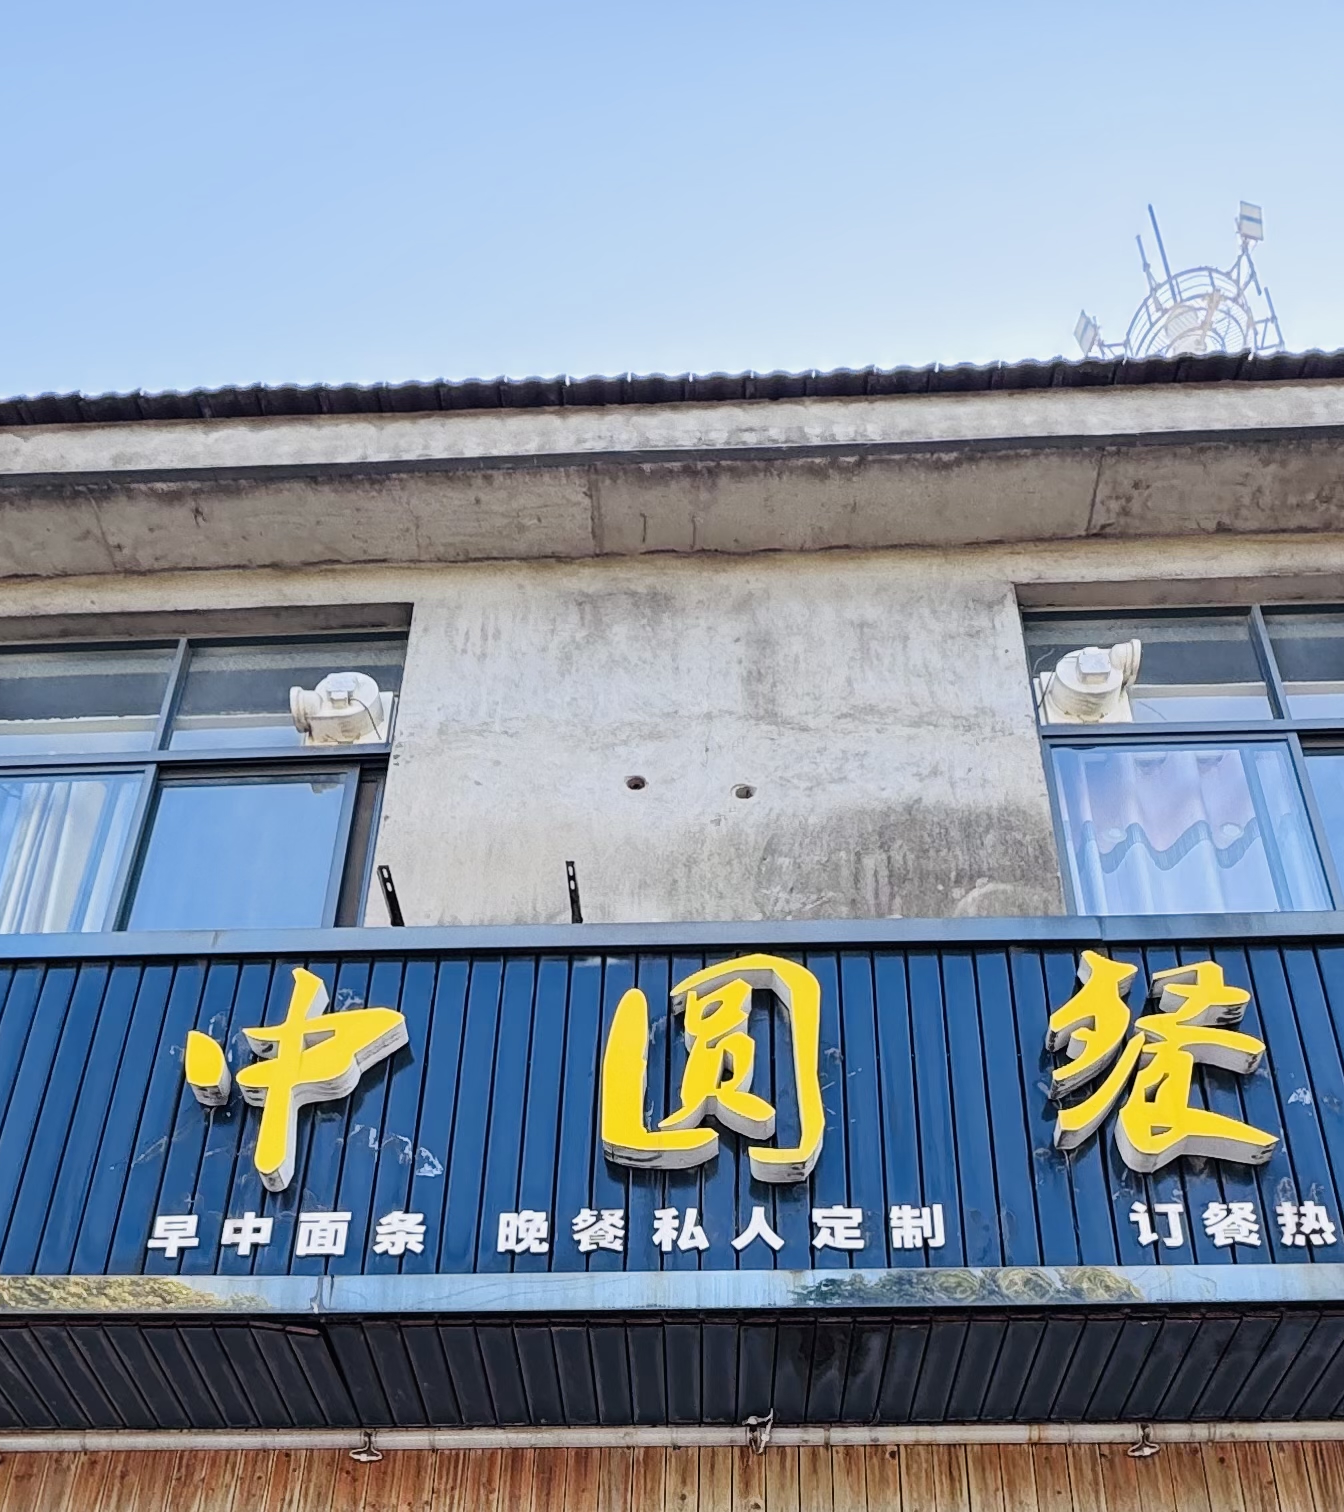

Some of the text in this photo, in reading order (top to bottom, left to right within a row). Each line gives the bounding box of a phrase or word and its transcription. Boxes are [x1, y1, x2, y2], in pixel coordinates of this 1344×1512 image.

[147, 1210, 427, 1258] 早中面条
[497, 1203, 947, 1254] 晚餐私人定制
